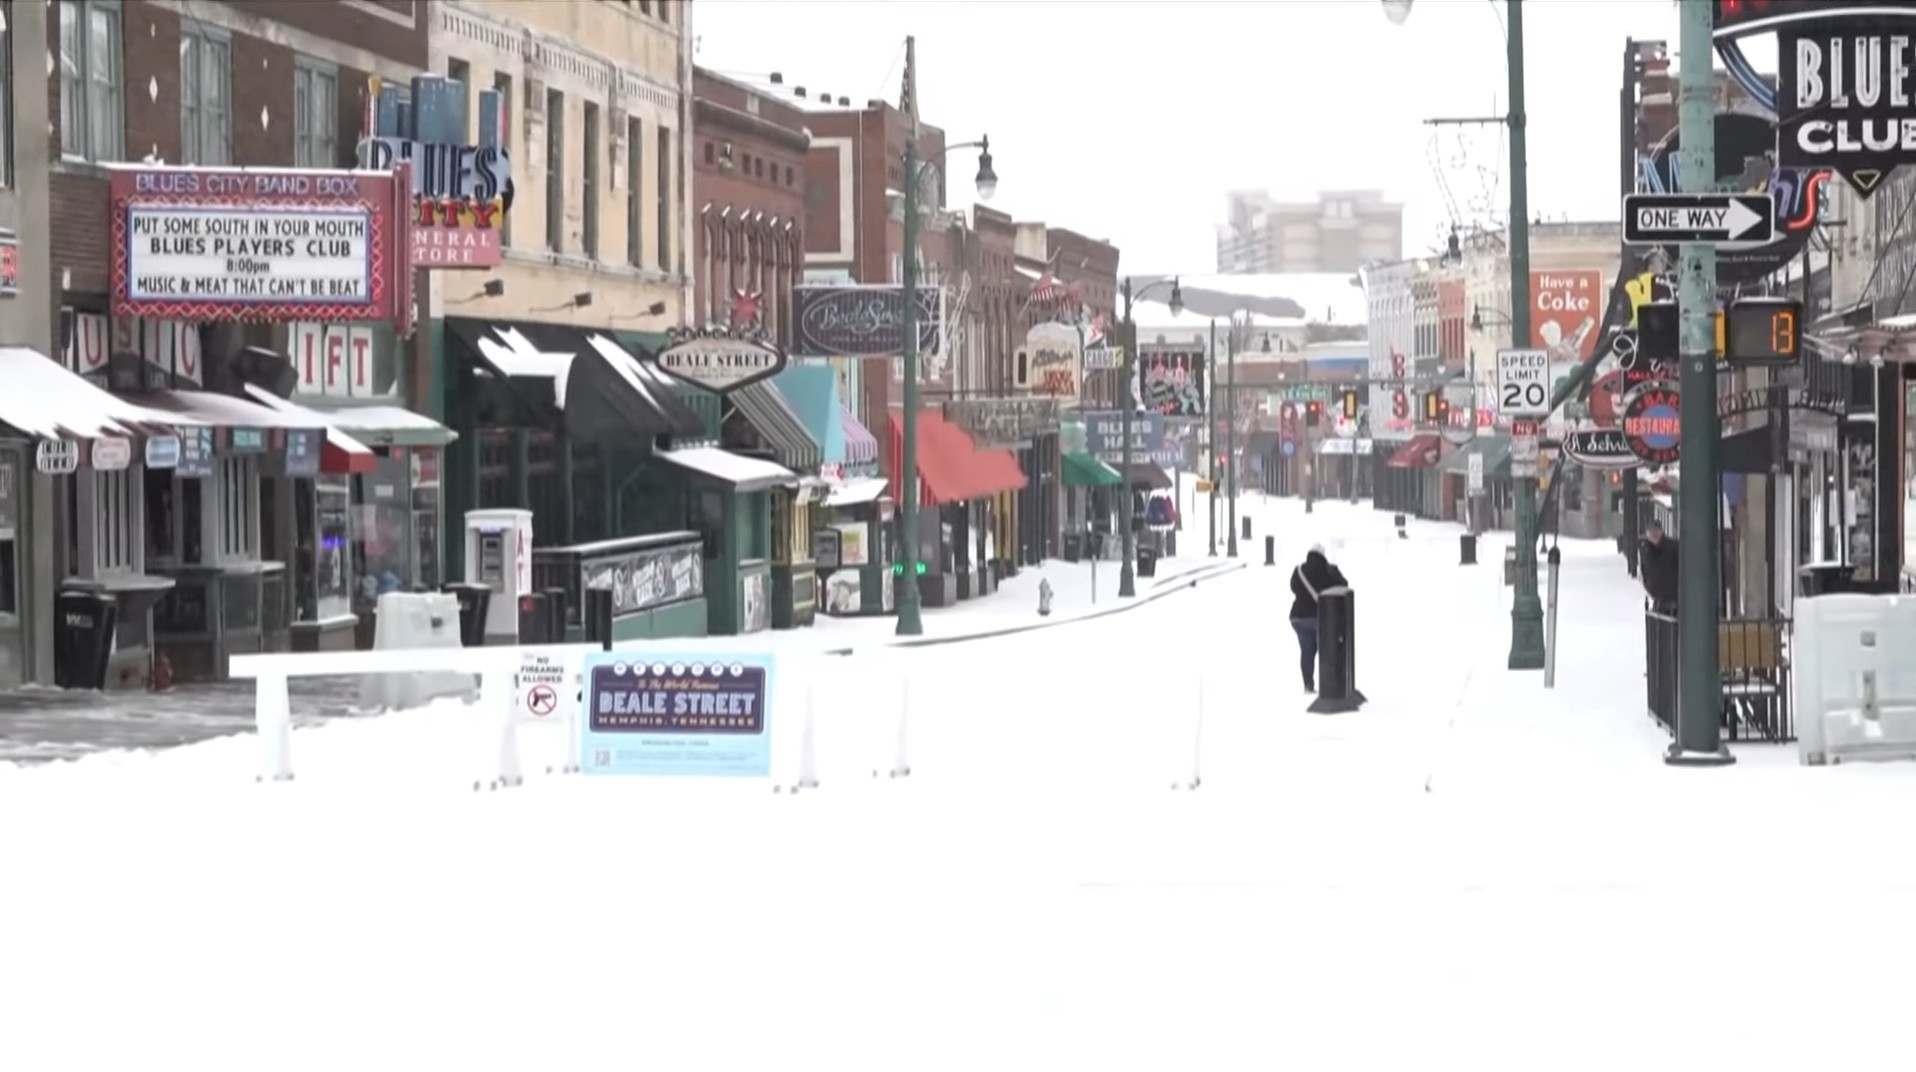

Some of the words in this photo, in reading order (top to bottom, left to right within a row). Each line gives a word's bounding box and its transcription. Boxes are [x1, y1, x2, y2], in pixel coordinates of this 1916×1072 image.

[1796, 36, 1916, 109] BLUE
[370, 140, 498, 200] BUES
[136, 173, 200, 192] BLUES
[206, 174, 249, 193] CITY
[255, 176, 309, 194] BAND
[317, 177, 358, 196] BOX
[417, 201, 499, 228] ITY
[1641, 210, 1680, 228] ONE
[1687, 210, 1727, 228] WAY
[134, 217, 158, 234] PUT
[164, 218, 199, 234] SOME
[205, 218, 249, 235] SOUTH
[255, 219, 268, 235] IN
[274, 219, 310, 236] YOUR
[315, 219, 364, 236] MOUTH
[150, 238, 205, 255] BLUES
[214, 239, 295, 256] PLAYERS
[307, 240, 351, 256] CLUB
[415, 231, 490, 247] NERAL
[417, 248, 473, 263] TORE
[226, 258, 270, 275] 8:00pm
[137, 276, 176, 294] MUSIC
[180, 278, 190, 293] &
[195, 277, 228, 294] MEAT
[234, 278, 266, 295] THAT
[269, 278, 306, 295] CAN'T
[311, 279, 325, 296] BE
[329, 280, 359, 297] BEAT
[1540, 275, 1573, 288] Have
[1580, 277, 1588, 288] a
[1537, 292, 1590, 311] Coke
[1772, 310, 1794, 353] 13
[82, 314, 197, 377] USIC
[305, 333, 369, 387] IFT
[667, 354, 712, 367] BEALE
[717, 354, 770, 367] STREET
[1501, 355, 1545, 367] SPEED
[1506, 369, 1541, 381] LIMIT
[1503, 383, 1545, 408] 20
[1625, 417, 1680, 436] RESTAURA
[1103, 435, 1147, 449] HAL
[664, 679, 689, 689] World
[599, 691, 667, 714] BEALE
[674, 691, 756, 715] STREET
[599, 716, 668, 726] MEMPHIS,
[672, 717, 754, 727] TENNESSEE
